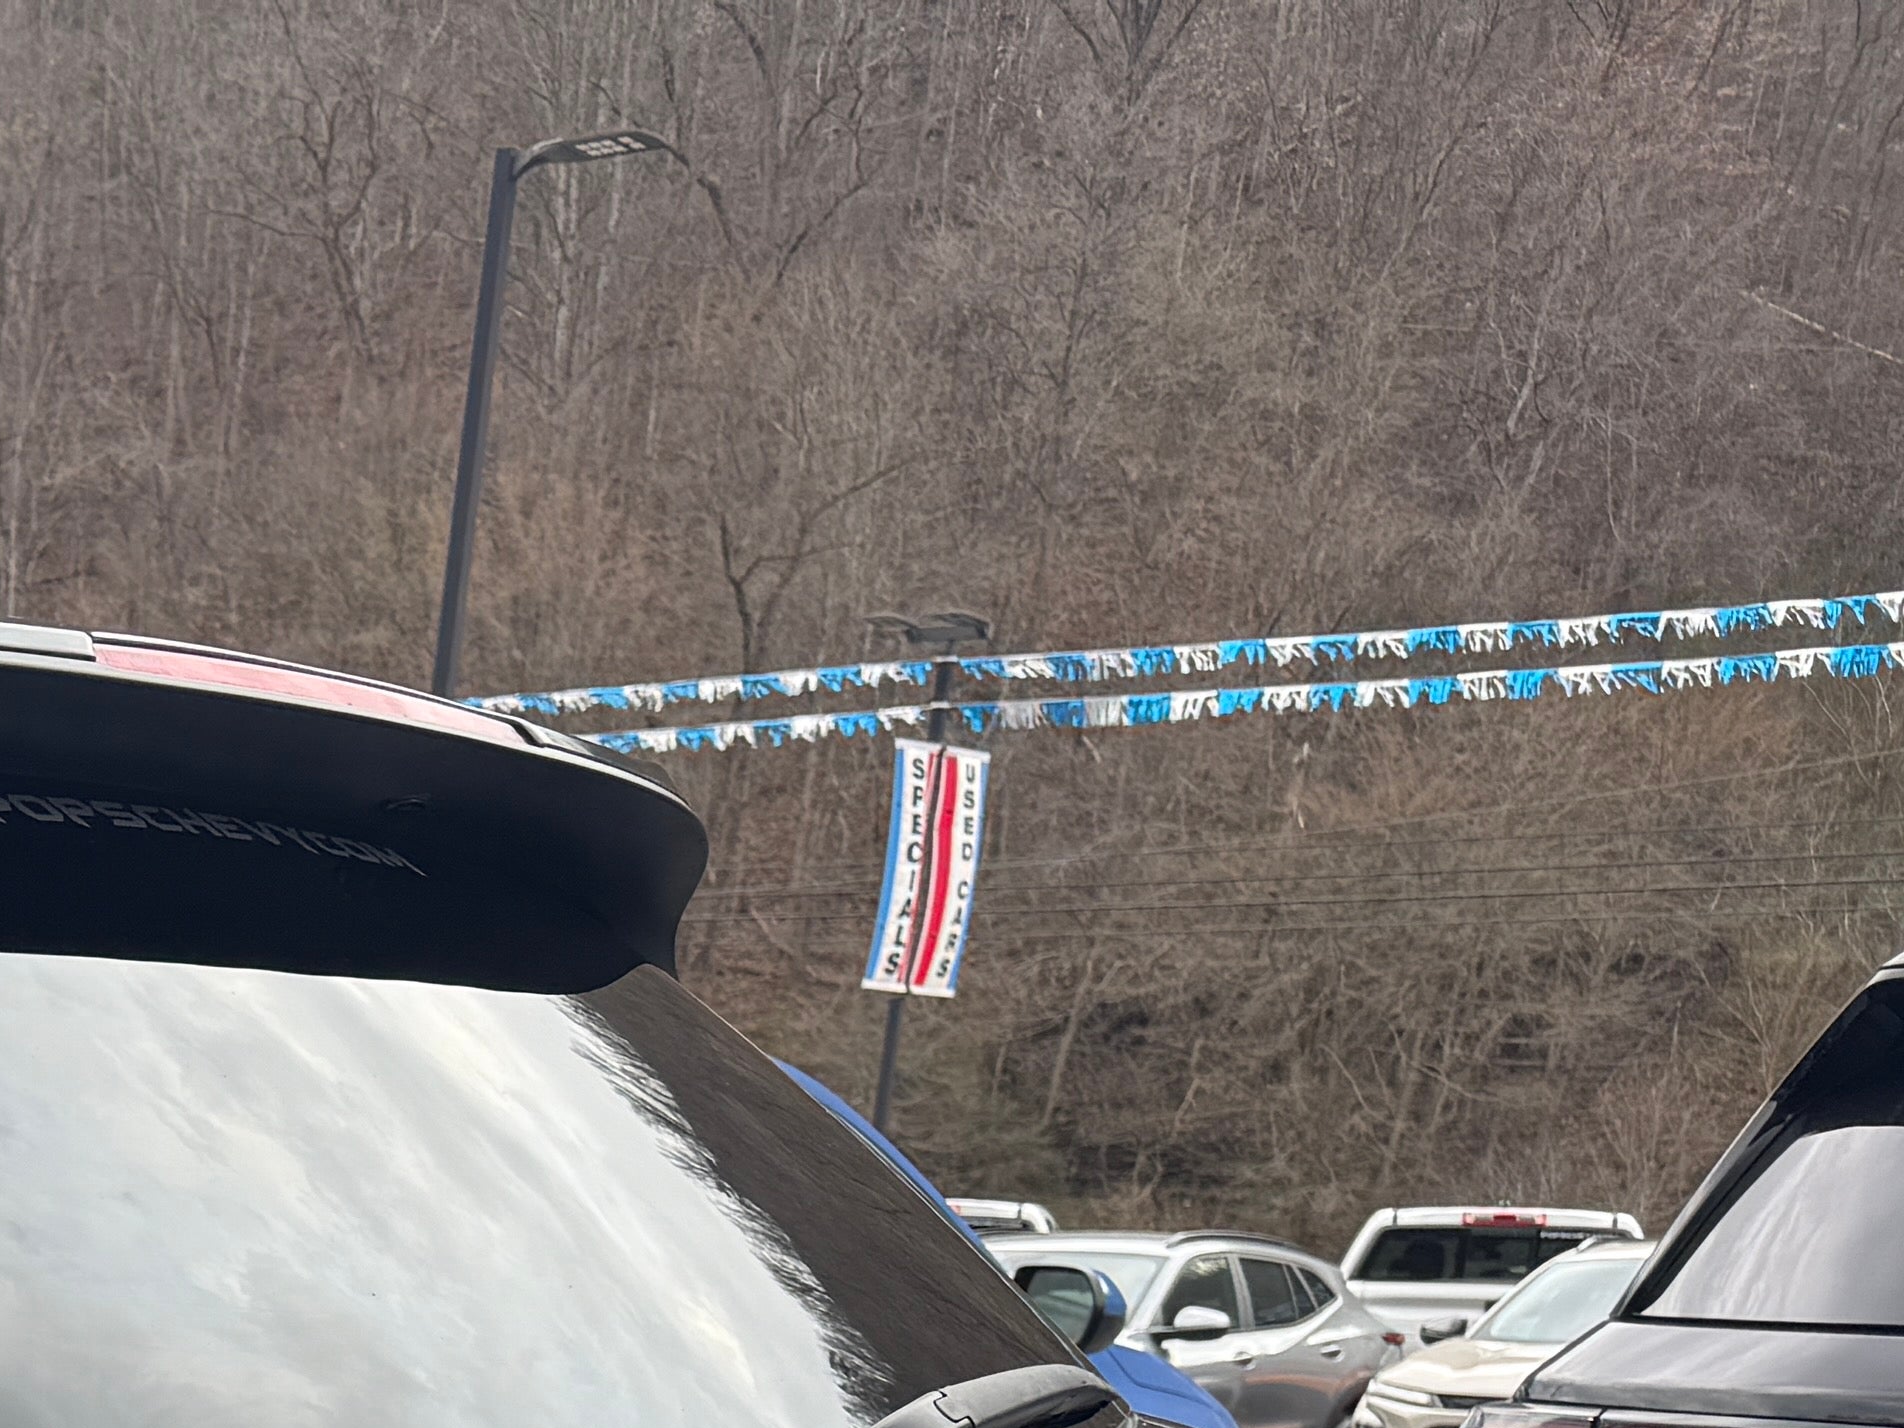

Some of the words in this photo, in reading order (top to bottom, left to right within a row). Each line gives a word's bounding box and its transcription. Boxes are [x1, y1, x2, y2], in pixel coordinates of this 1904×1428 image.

[961, 764, 976, 861] USED
[884, 757, 925, 977] SPECIALS
[936, 880, 969, 979] CARS
